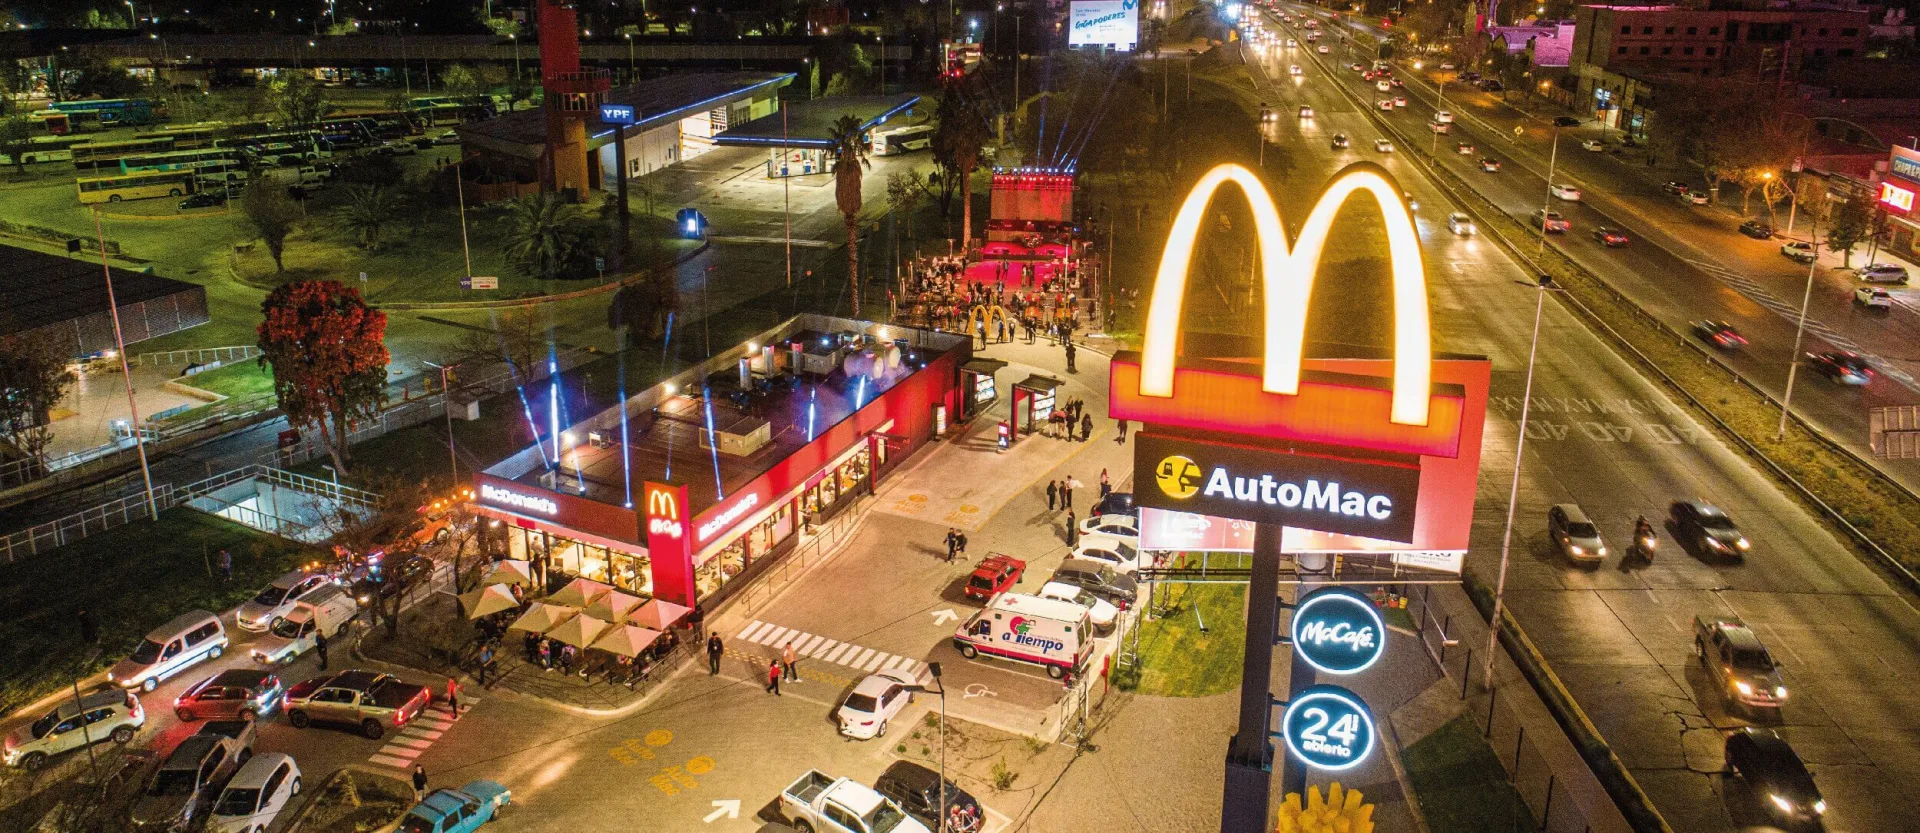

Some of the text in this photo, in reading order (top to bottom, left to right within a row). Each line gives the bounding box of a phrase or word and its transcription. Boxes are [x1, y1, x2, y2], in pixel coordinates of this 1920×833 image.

[1093, 12, 1125, 25] PODERES
[603, 109, 631, 119] YPF
[1576, 420, 1632, 443] 40
[482, 484, 557, 515] McDonald's
[1203, 467, 1393, 521] AutoMac
[699, 493, 758, 541] McDonald's
[1002, 632, 1012, 641] a
[1302, 739, 1351, 757] abierto
